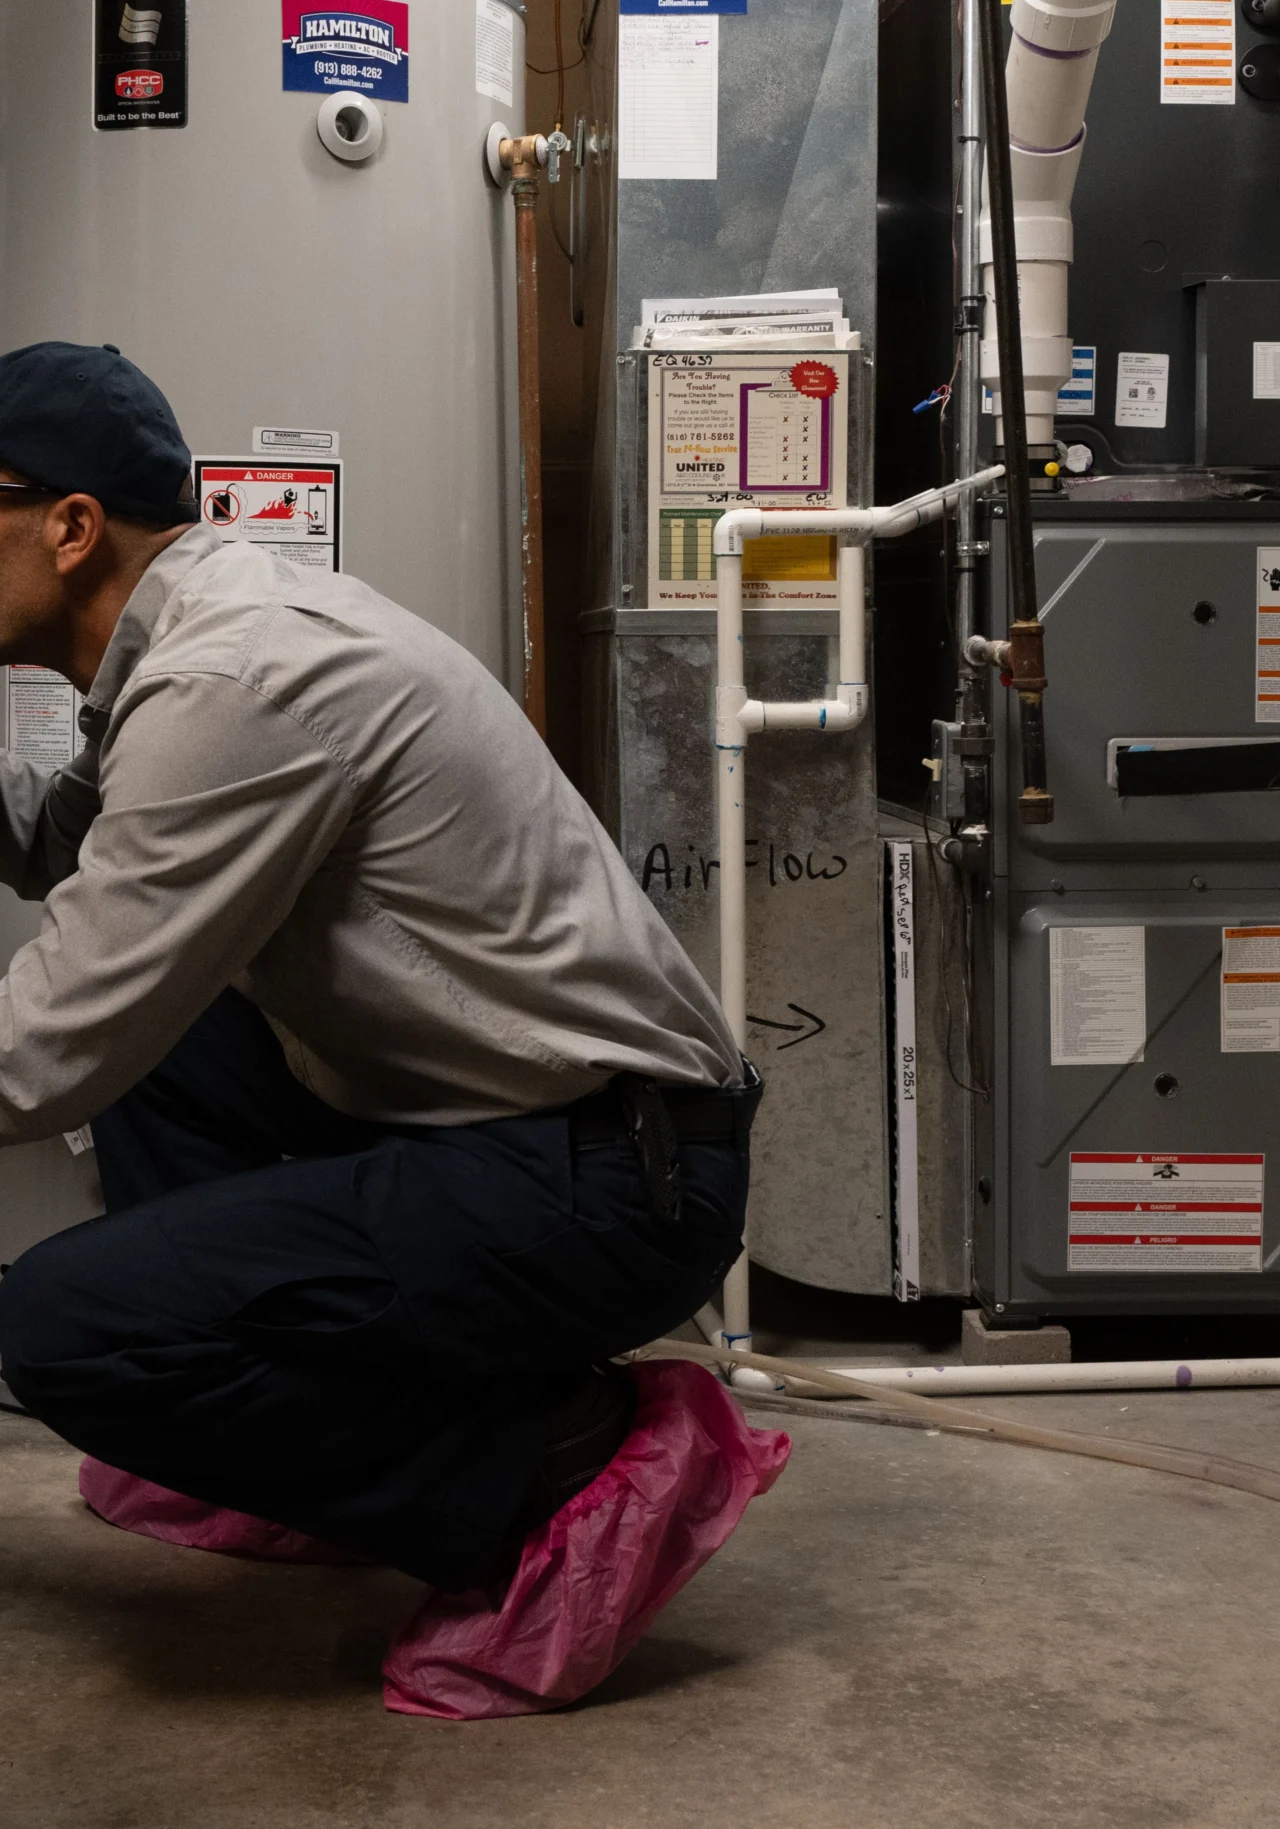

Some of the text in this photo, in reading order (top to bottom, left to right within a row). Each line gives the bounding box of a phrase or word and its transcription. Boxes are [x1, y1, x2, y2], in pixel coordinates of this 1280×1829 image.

[306, 20, 390, 46] HAMILTON
[298, 42, 328, 52] PLUMBING
[333, 42, 357, 50] HEATING
[376, 49, 396, 61] ROOTER
[314, 60, 382, 80] (913) 888-4262
[118, 75, 160, 86] PHCC
[323, 76, 374, 89] CallHamilton.com
[664, 315, 700, 323] DAIKIN
[780, 324, 830, 332] WARRANTY
[704, 372, 730, 381] Having
[713, 445, 738, 453] Service
[676, 463, 725, 472] UNITED
[256, 472, 294, 480] DANGER
[642, 842, 720, 892] Air
[899, 853, 910, 880] HDX
